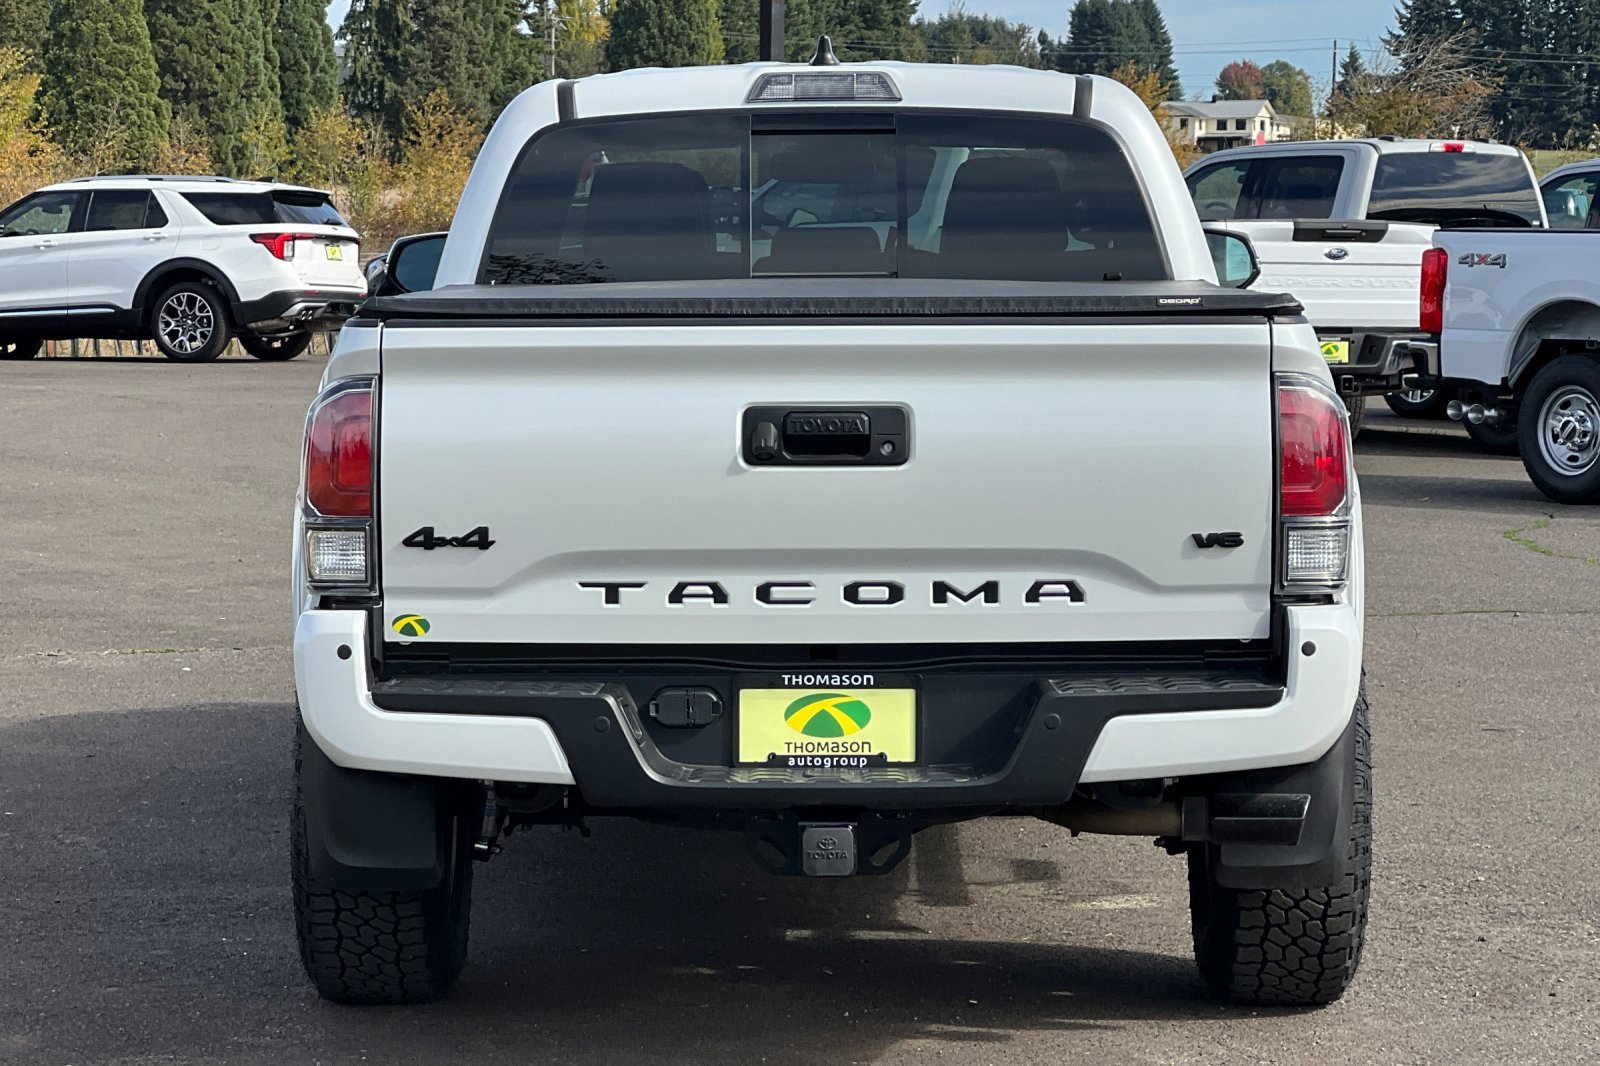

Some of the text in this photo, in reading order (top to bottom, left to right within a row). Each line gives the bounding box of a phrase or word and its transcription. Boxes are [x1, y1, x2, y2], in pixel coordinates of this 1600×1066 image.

[1346, 277, 1419, 289] DUTY
[790, 418, 864, 433] TOYOTA
[1191, 531, 1244, 548] V6
[577, 580, 1086, 606] TACOMA
[787, 756, 868, 768] autogroup
[807, 850, 849, 860] TOYOTA
